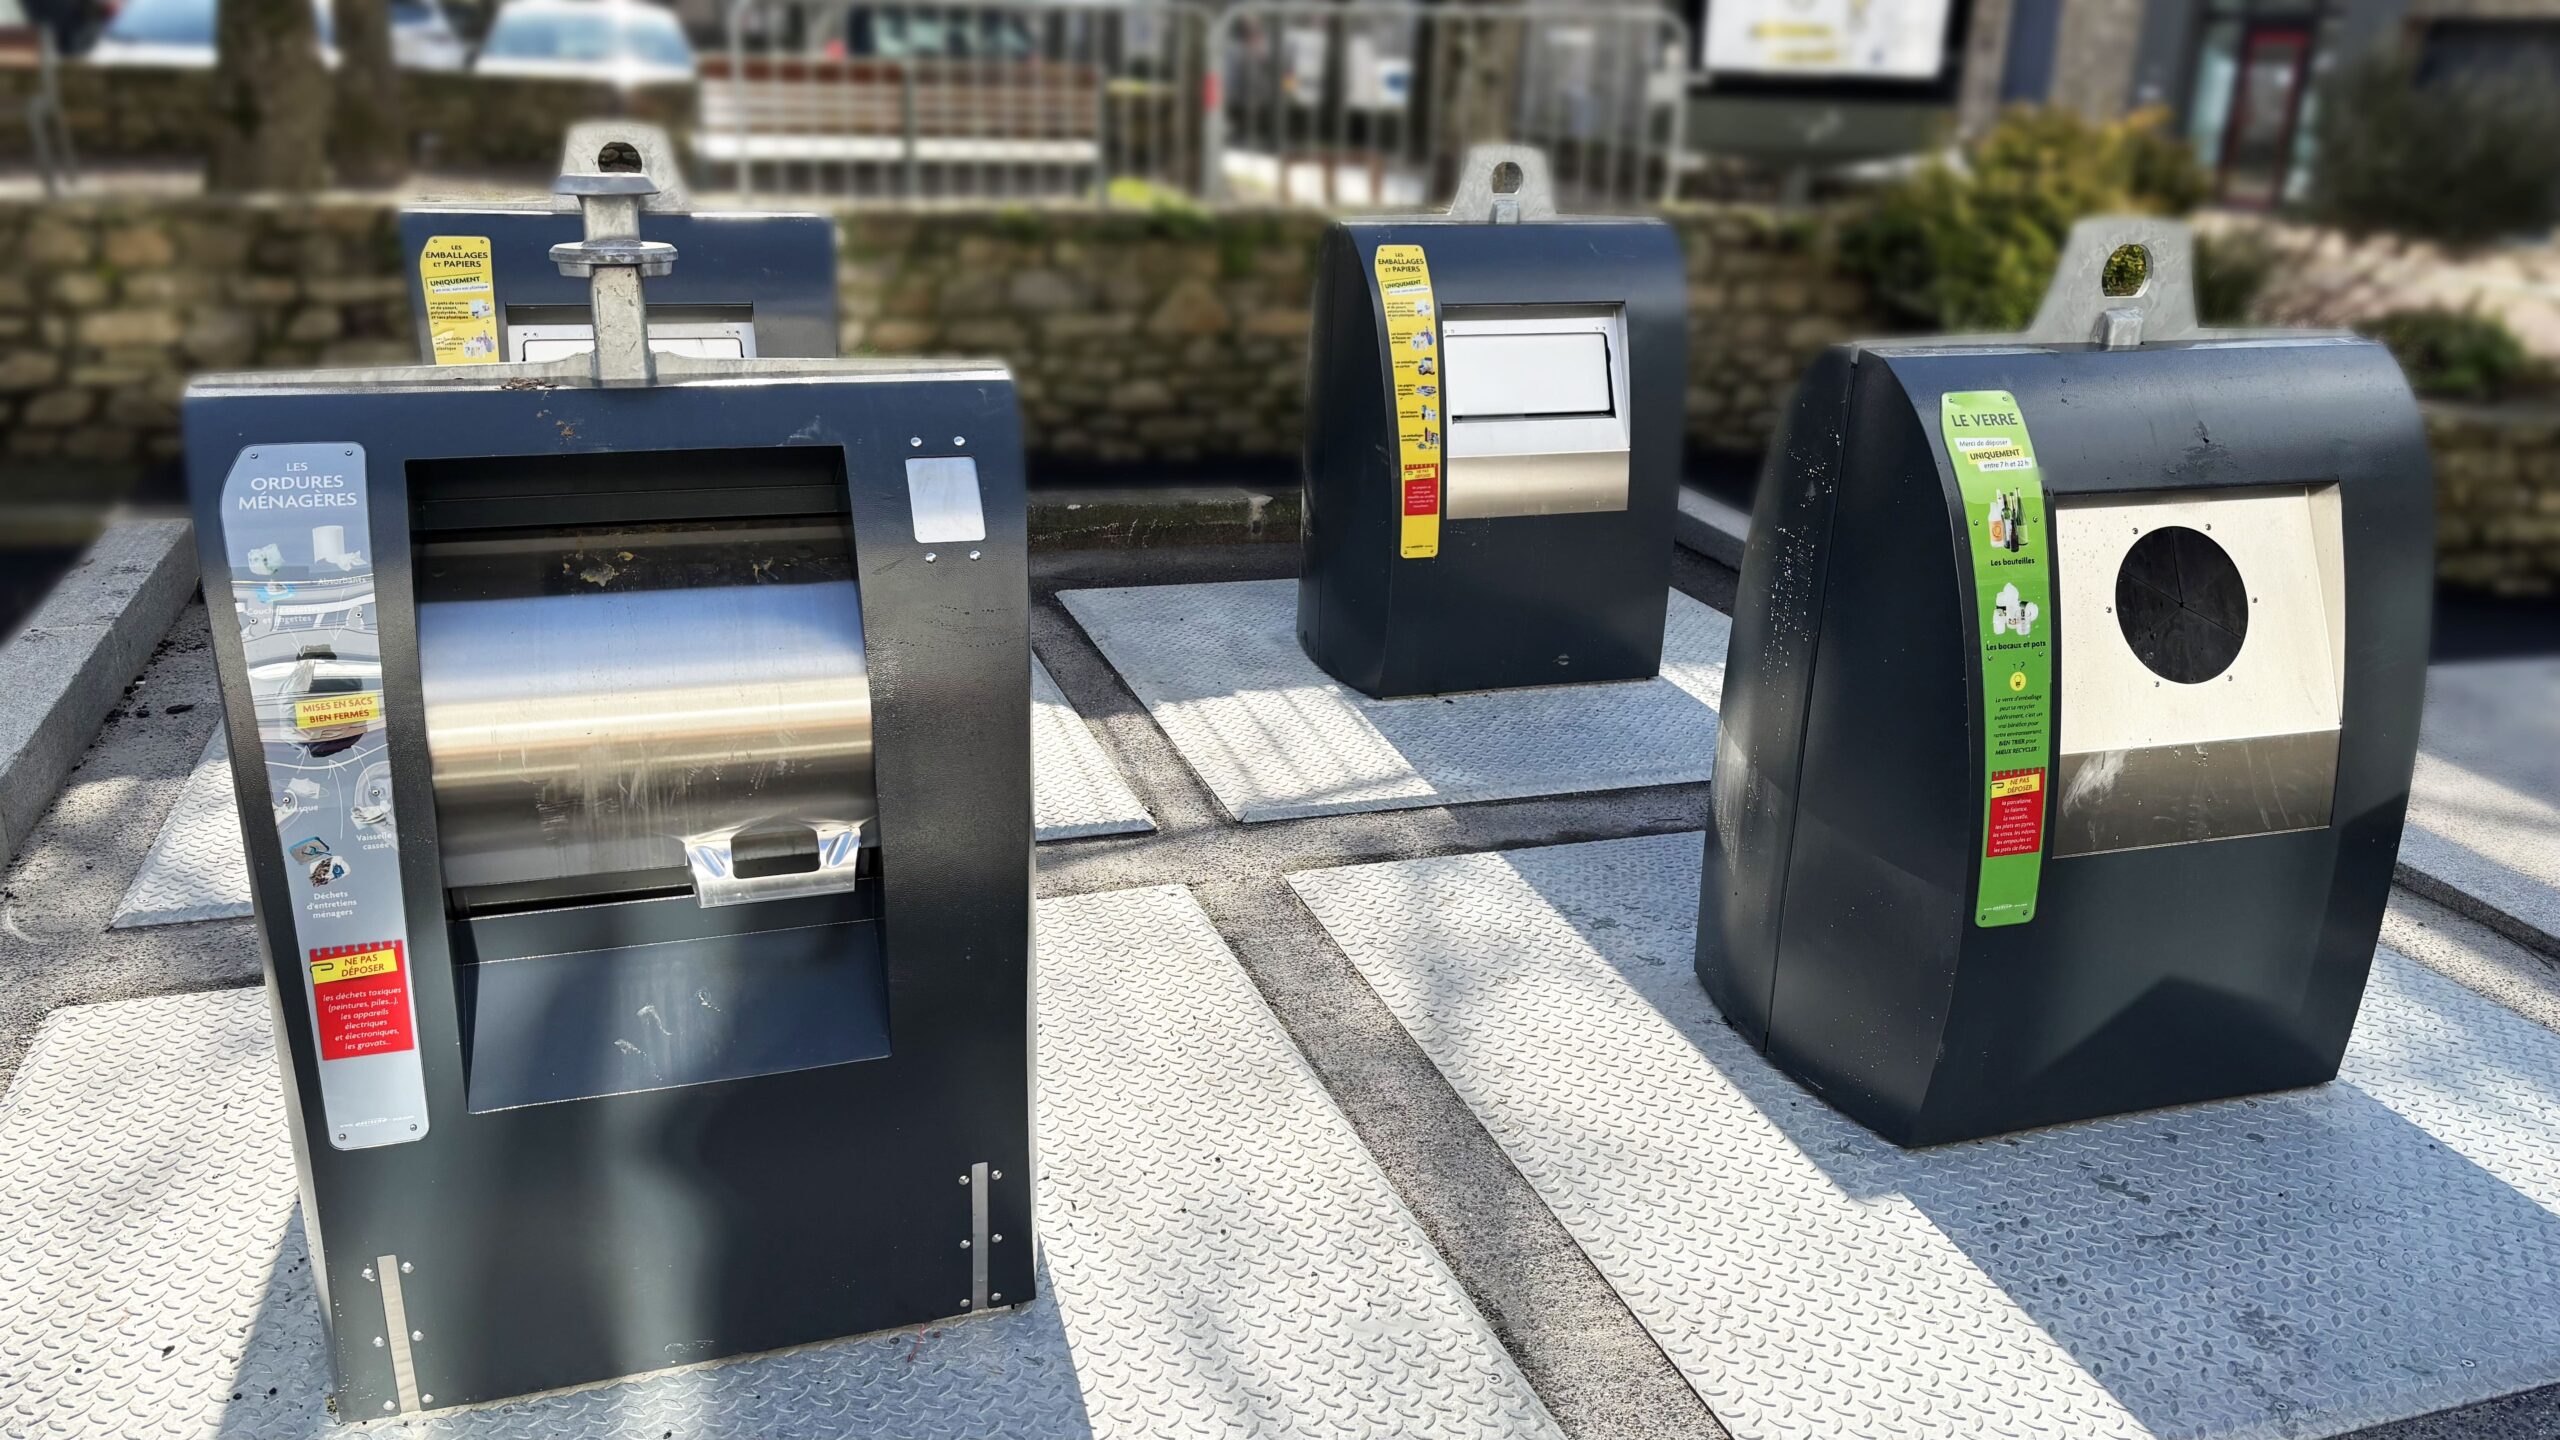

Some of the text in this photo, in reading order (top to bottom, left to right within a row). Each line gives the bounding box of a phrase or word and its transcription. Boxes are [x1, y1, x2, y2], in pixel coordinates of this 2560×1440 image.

[430, 276, 480, 286] UNIQUEMENT
[1385, 280, 1421, 289] UNIQUEMENT
[1951, 413, 2018, 427] LE VERRE
[1970, 449, 2020, 460] UNIQUEMENT
[286, 462, 308, 471] LES
[251, 475, 344, 491] ORDURES
[238, 491, 357, 510] MÉNAGÈRES
[2003, 557, 2035, 566] bouteilles
[2031, 640, 2046, 649] pots
[303, 703, 331, 713] MISES
[349, 697, 373, 707] SACS
[310, 714, 332, 723] BIEN
[2007, 784, 2032, 793] DÉPOSER
[356, 832, 392, 842] Vaisselle
[314, 891, 348, 900] Déchets
[307, 900, 357, 910] d'entretiens
[313, 910, 353, 919] ménagers
[345, 954, 378, 966] NE PAS
[342, 963, 384, 977] DÉPOSER
[336, 991, 366, 1000] déchets
[368, 987, 401, 998] toxiques
[328, 1001, 369, 1013] (peintures,
[353, 1008, 389, 1020] appareils
[345, 1019, 388, 1030] électriques
[345, 1029, 399, 1040] électroniques,
